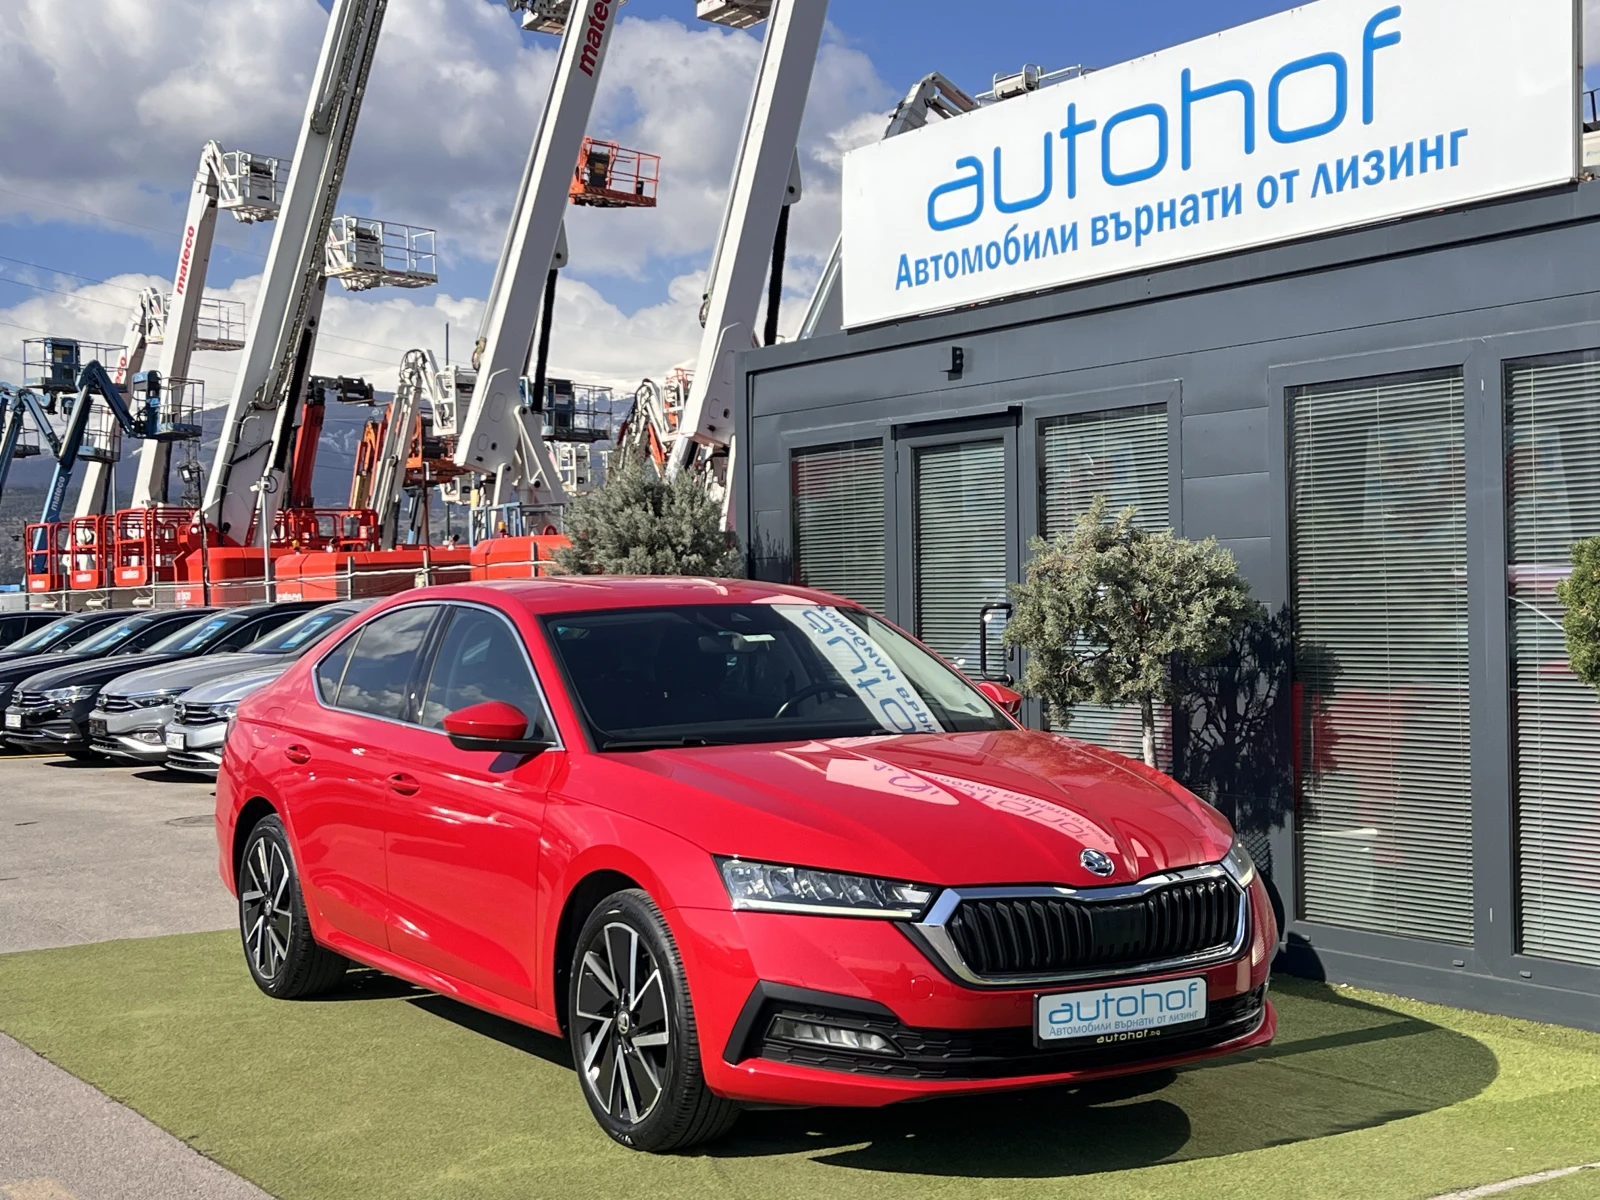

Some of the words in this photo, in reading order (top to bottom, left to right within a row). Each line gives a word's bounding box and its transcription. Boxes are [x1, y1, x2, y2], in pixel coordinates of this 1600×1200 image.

[579, 0, 612, 77] mate
[926, 5, 1401, 232] autohof
[895, 223, 1079, 290] Автомобили
[1091, 182, 1243, 248] върнати
[1257, 169, 1300, 209] от
[1310, 128, 1468, 199] лизинг
[176, 225, 195, 295] mateco
[51, 476, 66, 511] mateco
[1048, 982, 1198, 1025] autohof
[1048, 1020, 1112, 1037] Автомобили
[1114, 1016, 1155, 1031] върнати
[1157, 1014, 1167, 1025] от
[1168, 1010, 1199, 1024] лизинг
